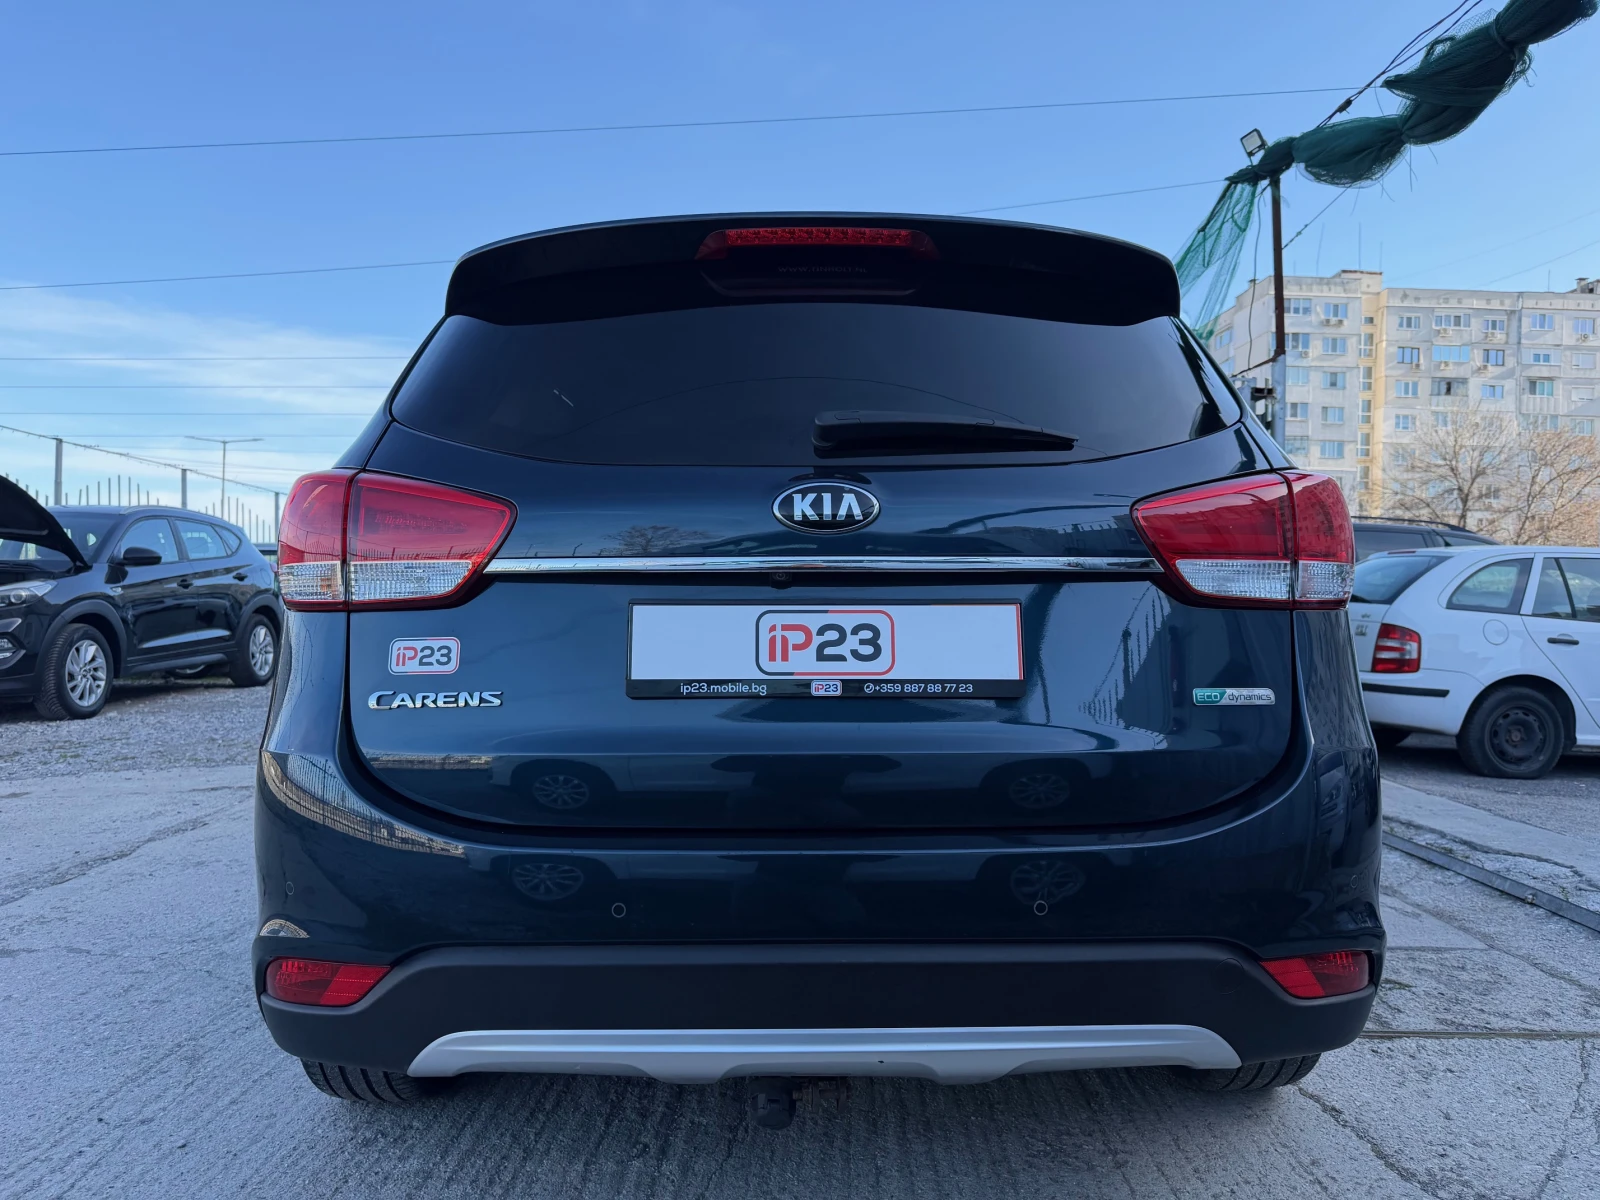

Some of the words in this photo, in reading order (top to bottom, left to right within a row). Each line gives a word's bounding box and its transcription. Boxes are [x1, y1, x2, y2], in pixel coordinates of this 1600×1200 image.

[791, 492, 864, 521] KIA
[680, 682, 767, 696] ip23.mobile.bg
[875, 683, 901, 693] +359
[903, 683, 925, 693] 887
[927, 683, 942, 693] 88
[944, 683, 957, 693] 77
[958, 683, 973, 693] 23
[367, 690, 503, 710] CARENS
[1197, 692, 1220, 701] ECO
[1228, 692, 1272, 703] dynamics
